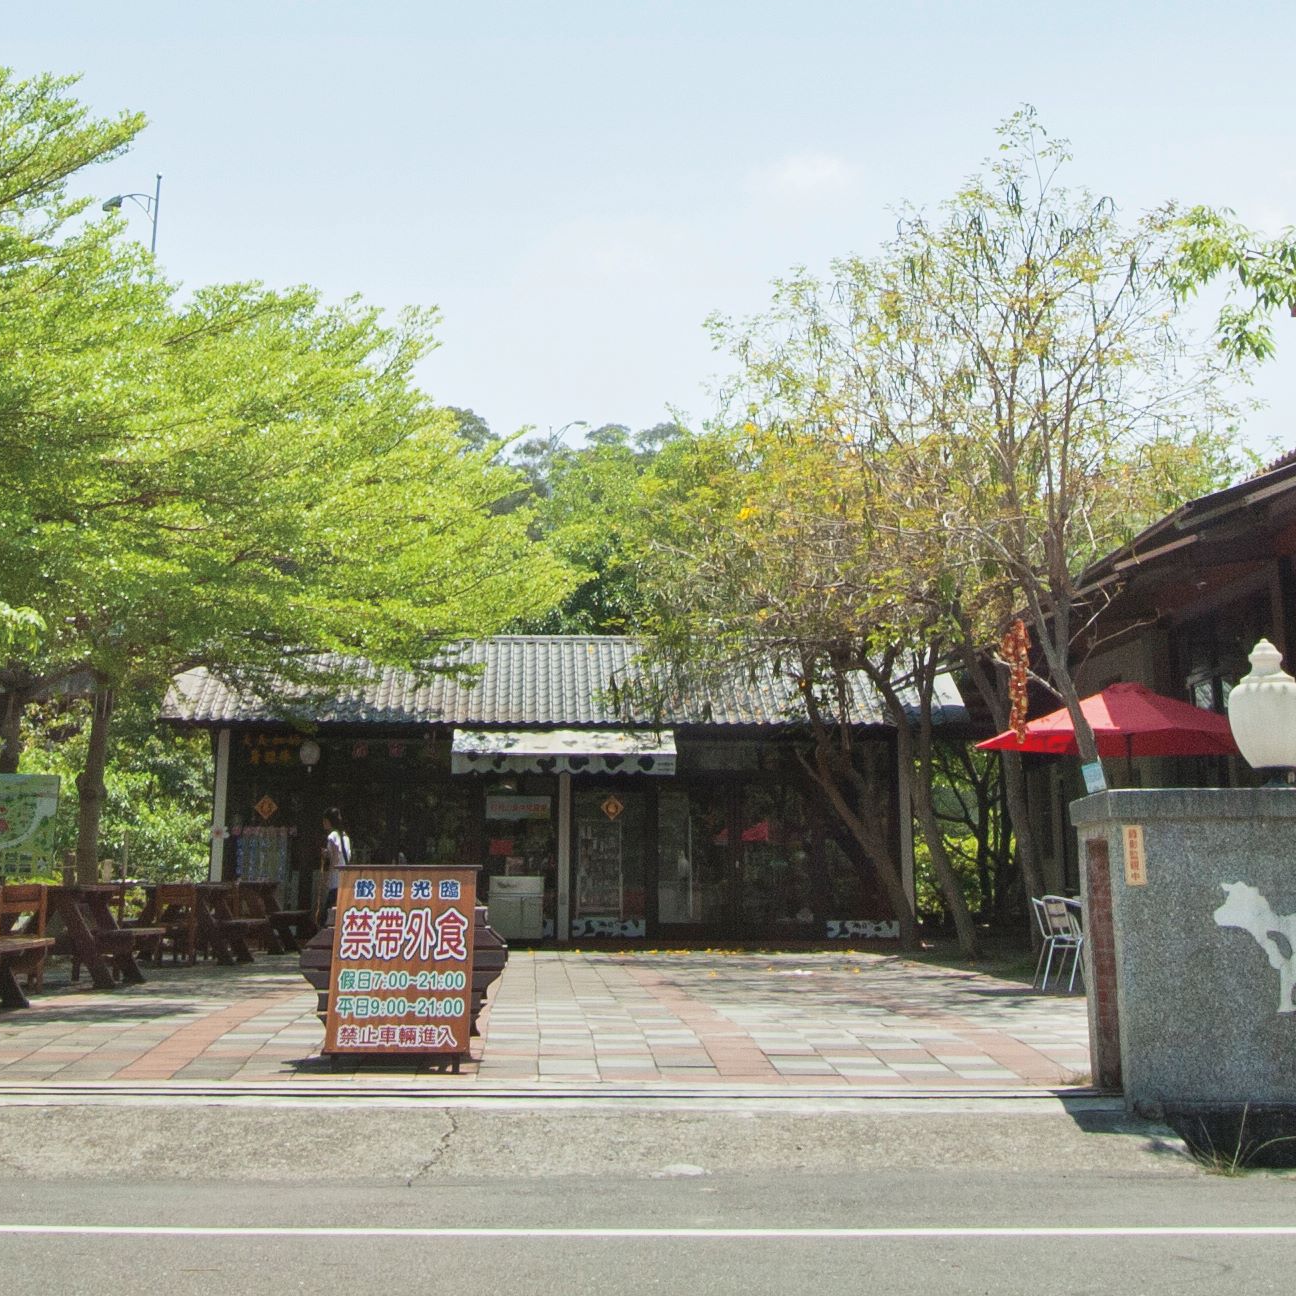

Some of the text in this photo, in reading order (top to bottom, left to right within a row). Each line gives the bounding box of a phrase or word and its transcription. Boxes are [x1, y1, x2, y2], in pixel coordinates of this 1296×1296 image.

[355, 879, 461, 899] 歡迎光臨
[340, 907, 468, 960] 禁帶外食
[337, 1024, 457, 1047] 禁止車輛進入
